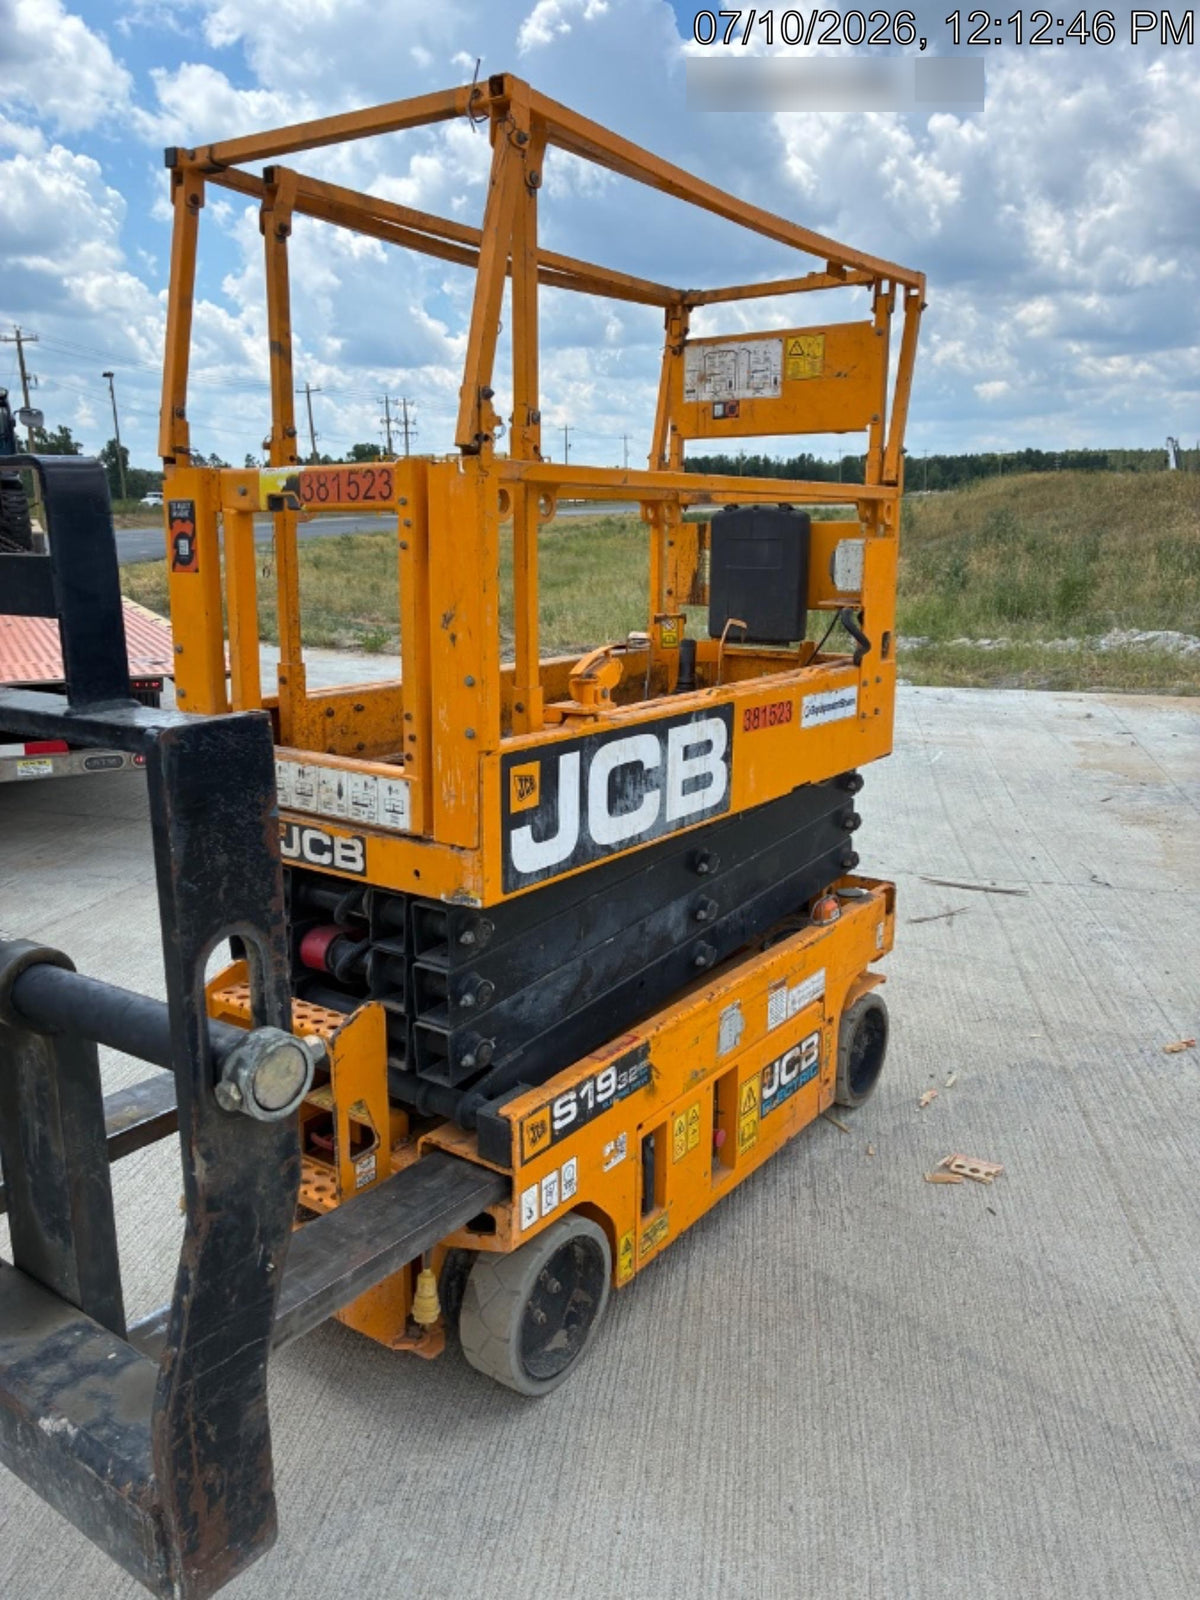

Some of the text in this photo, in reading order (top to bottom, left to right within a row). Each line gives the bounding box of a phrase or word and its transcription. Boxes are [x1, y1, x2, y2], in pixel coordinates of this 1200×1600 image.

[301, 469, 392, 502] 381523
[744, 700, 792, 732] 381523
[510, 717, 728, 874] JCB
[280, 826, 365, 872] JCB
[762, 1032, 819, 1100] JCB
